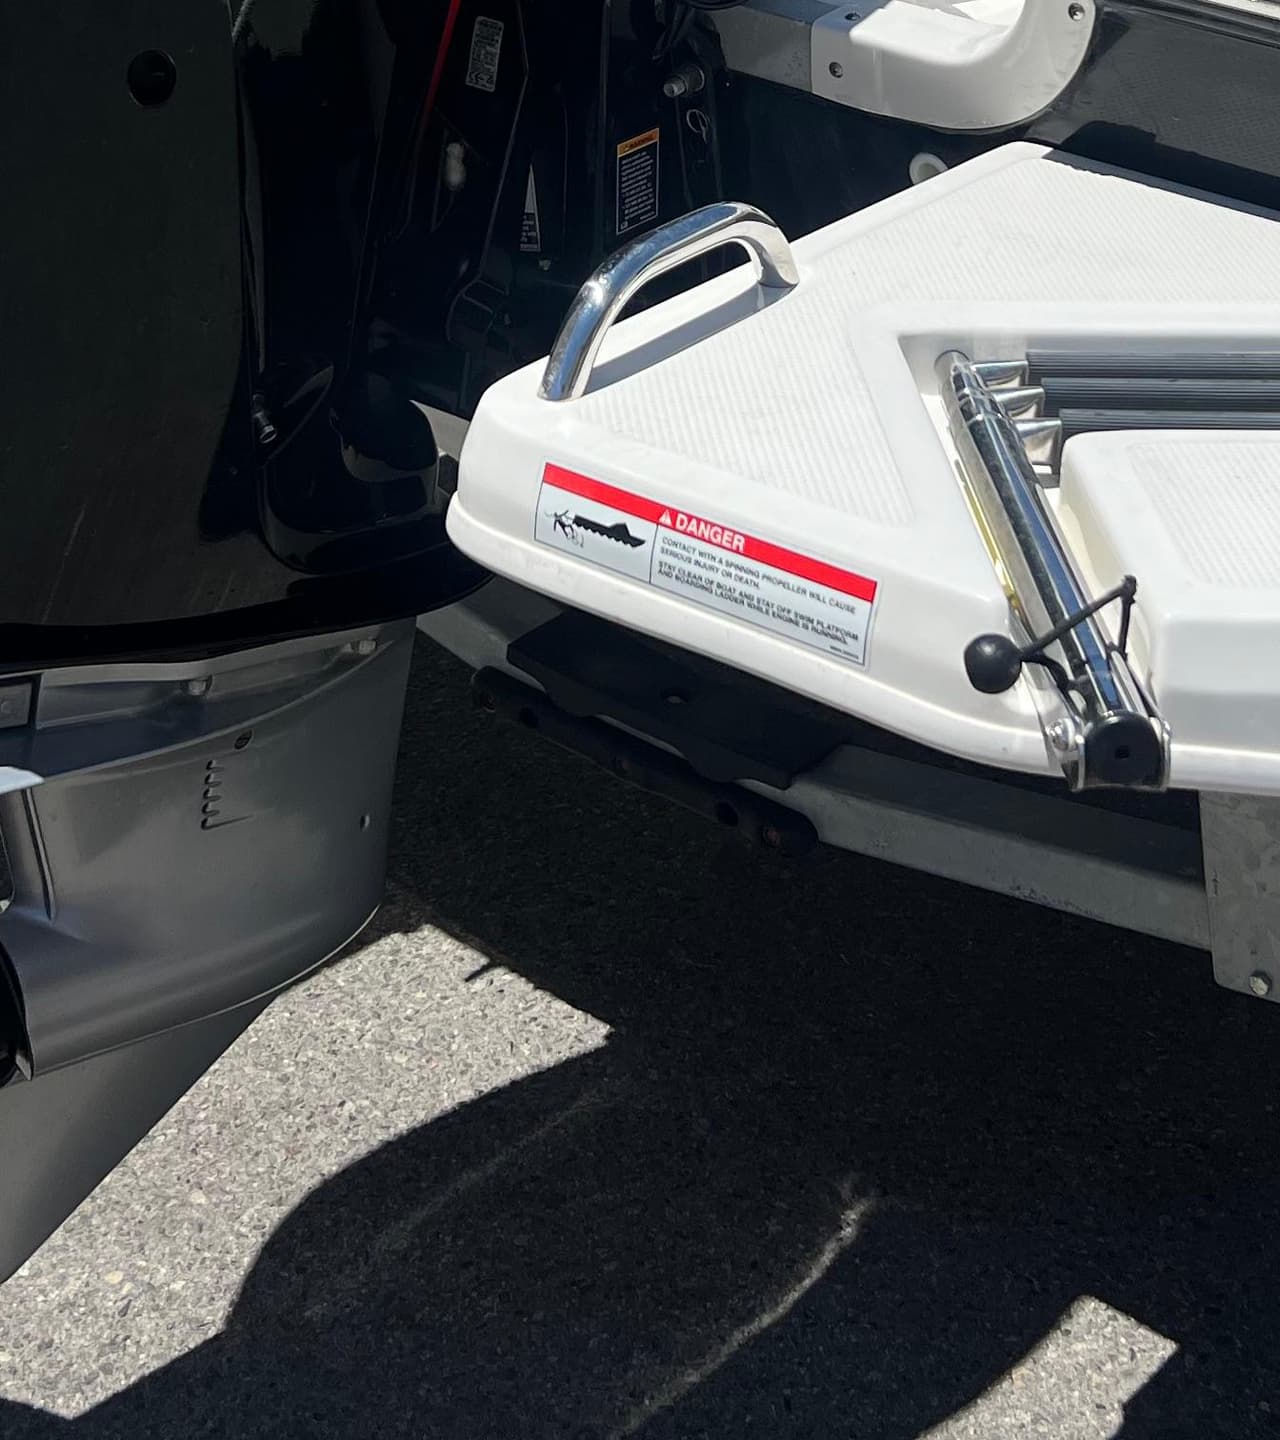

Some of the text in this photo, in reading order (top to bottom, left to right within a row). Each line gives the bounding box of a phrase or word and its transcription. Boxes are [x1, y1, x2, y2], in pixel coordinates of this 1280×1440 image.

[674, 513, 746, 552] DANGER
[660, 547, 691, 564] SERIOUS
[693, 559, 718, 574] INJURY
[720, 569, 732, 579] OR
[662, 536, 696, 555] CONTACT
[697, 549, 715, 562] WITH
[761, 573, 807, 596] PROPELLER
[829, 597, 856, 614] CAUSE
